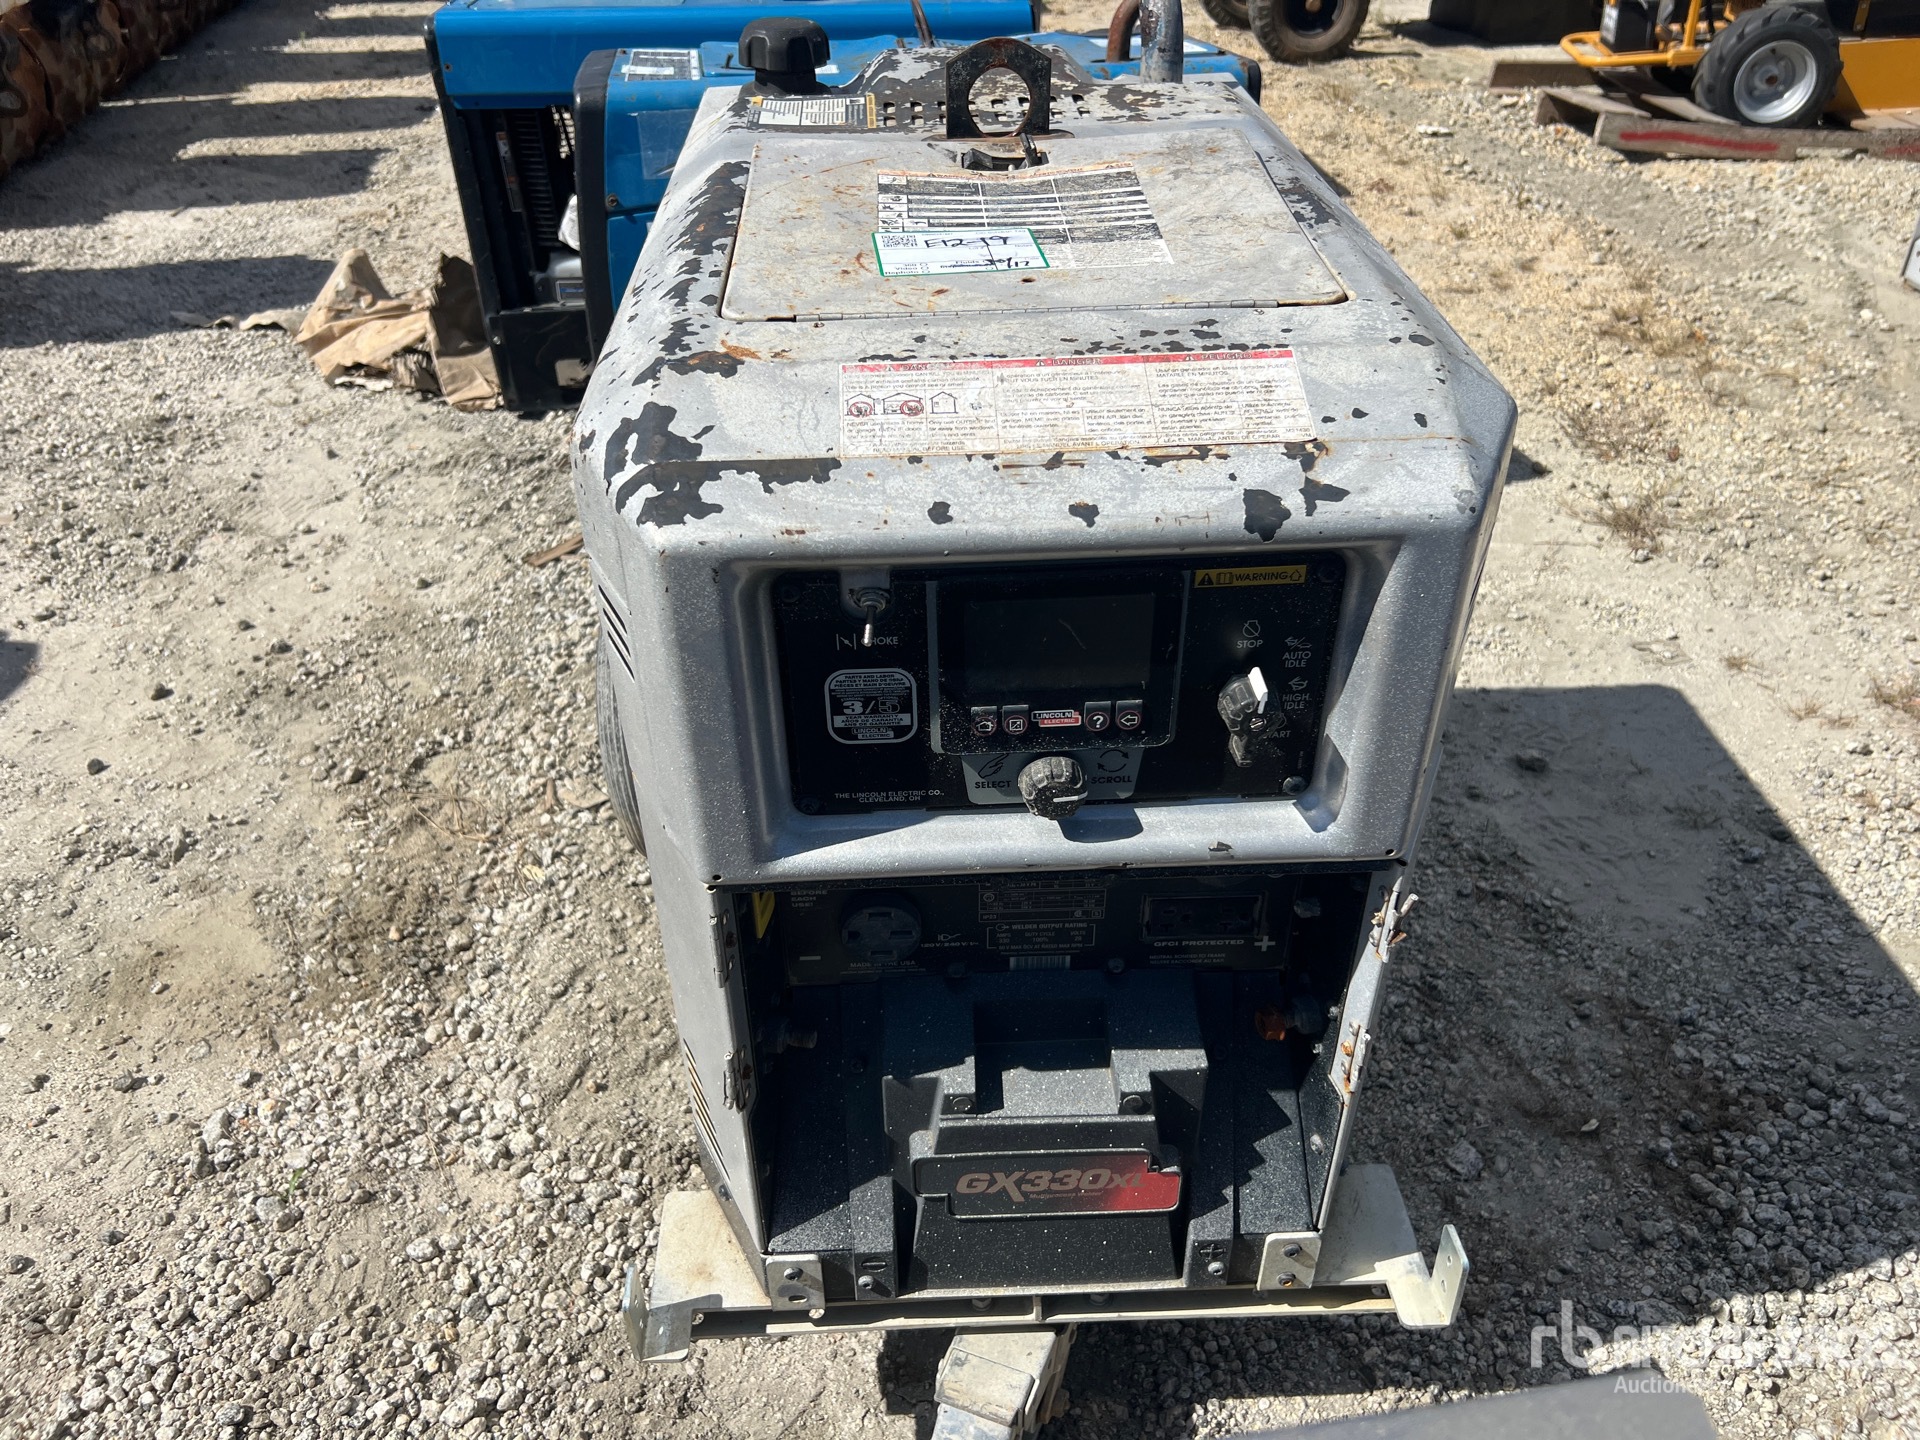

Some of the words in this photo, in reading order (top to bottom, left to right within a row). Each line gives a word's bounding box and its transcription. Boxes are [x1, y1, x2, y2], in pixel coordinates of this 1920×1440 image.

[924, 236, 1011, 248] E12-19
[1234, 572, 1289, 581] WARNING
[1282, 651, 1312, 660] AUTO
[1282, 693, 1309, 701] HIGH
[1284, 701, 1305, 709] IDLE
